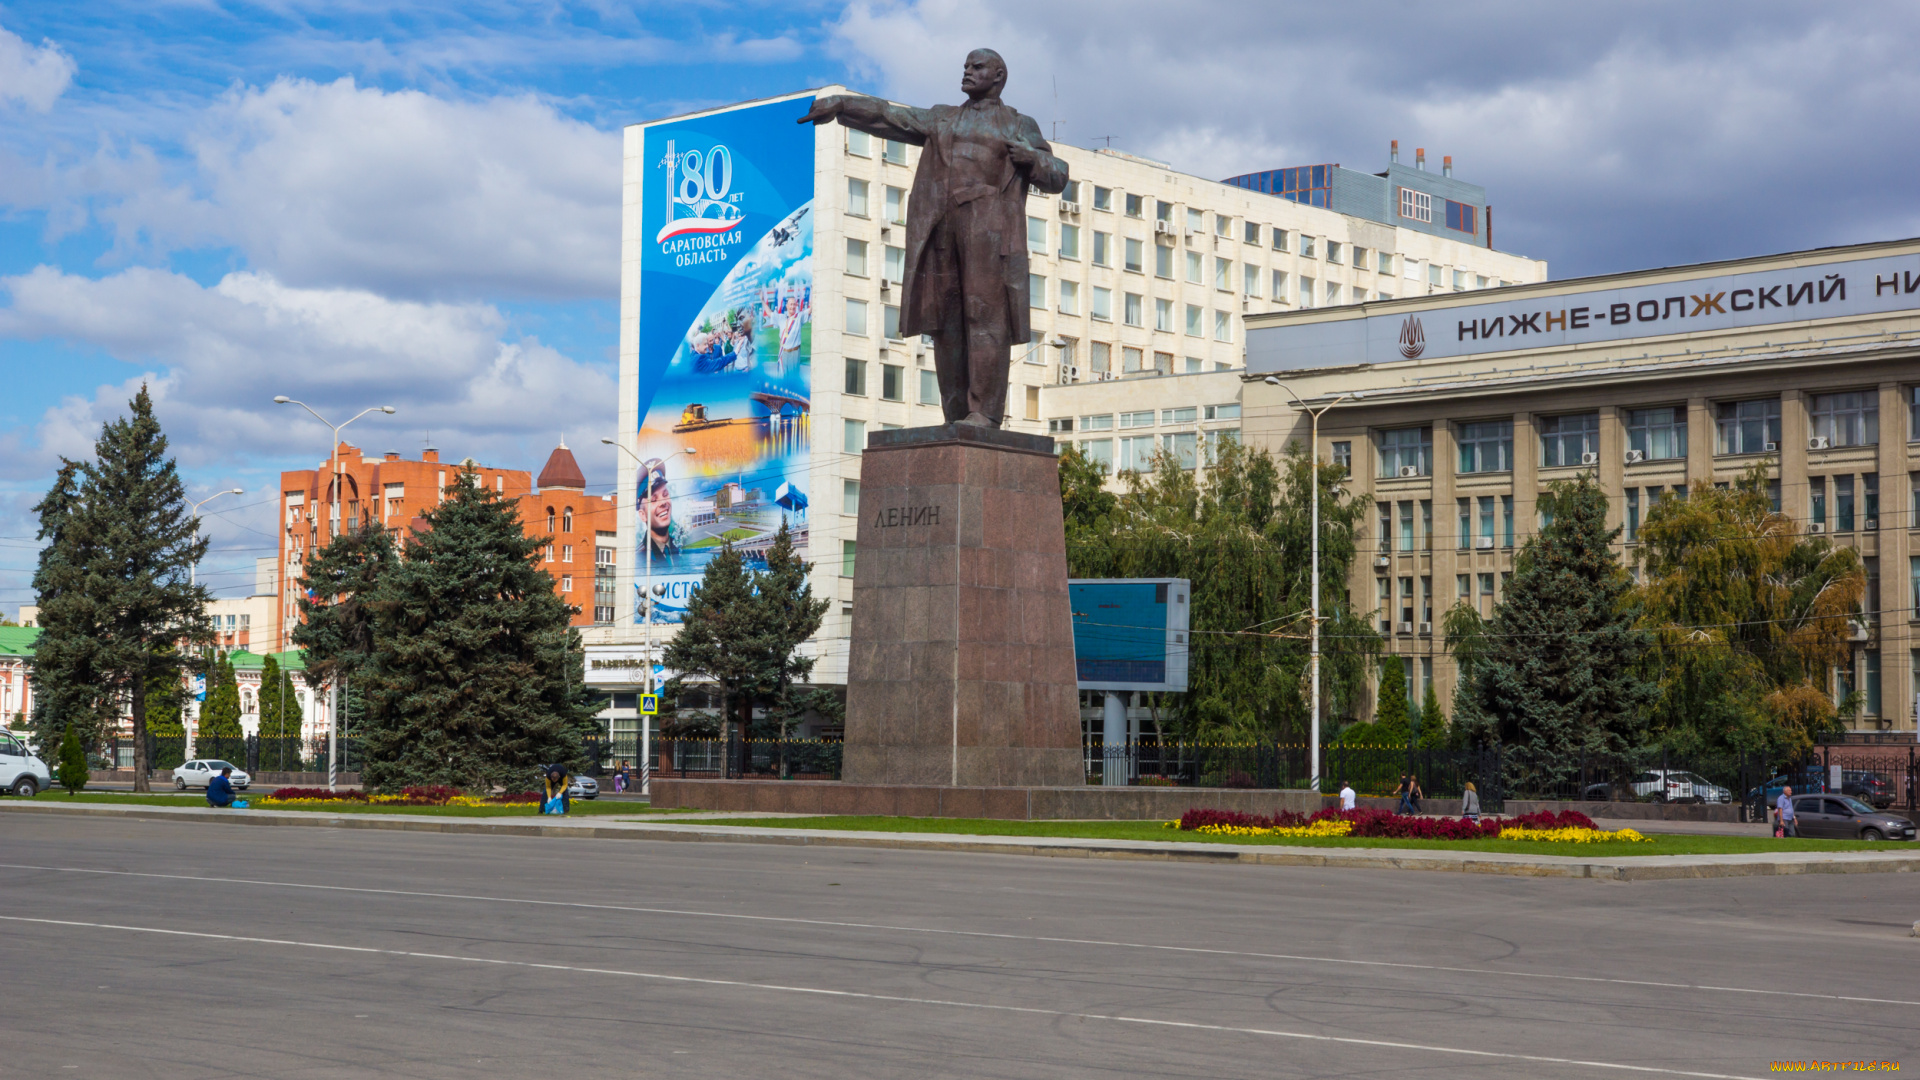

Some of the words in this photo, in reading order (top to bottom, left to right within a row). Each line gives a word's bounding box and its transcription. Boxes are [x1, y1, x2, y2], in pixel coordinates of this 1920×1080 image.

[680, 145, 732, 205] 80
[728, 192, 744, 204] ЛЕТ
[662, 231, 742, 254] САРАТОВСКАЯ
[676, 248, 727, 267] ОБЛАСТЬ
[1458, 274, 1846, 341] НИЖНЕ-ВОЛЖСКИЙ
[874, 506, 940, 528] ЛЕНИН
